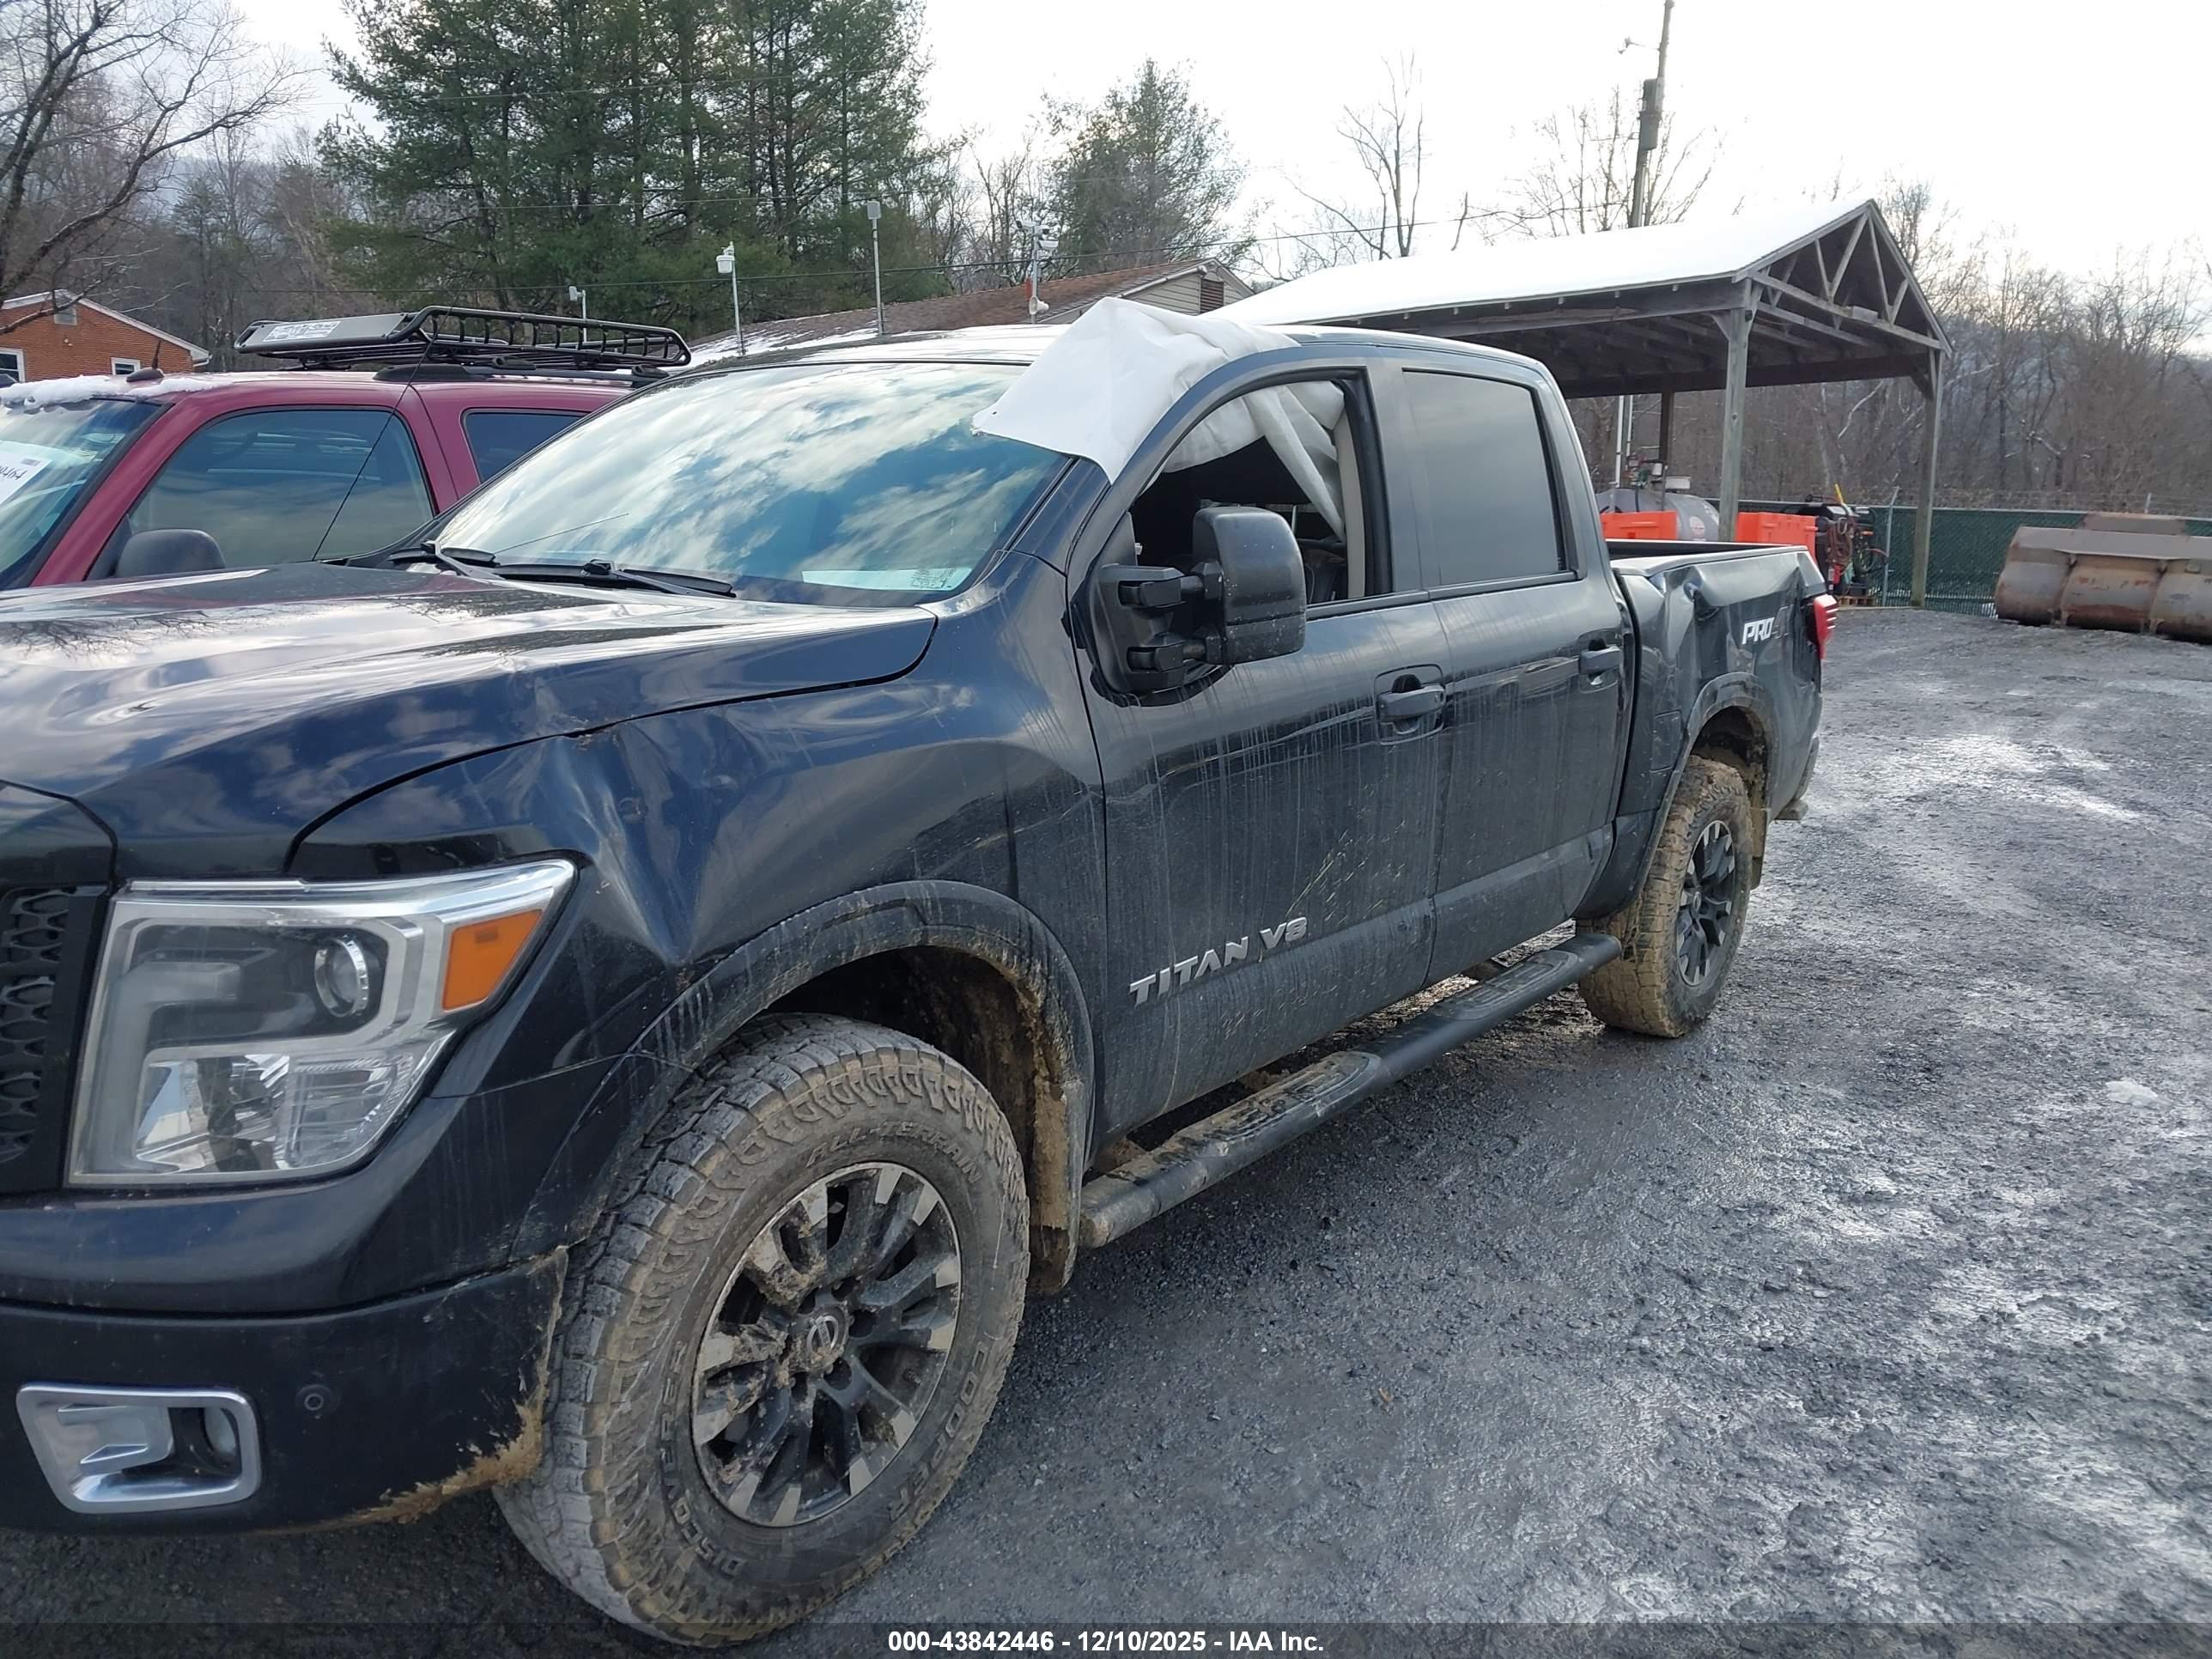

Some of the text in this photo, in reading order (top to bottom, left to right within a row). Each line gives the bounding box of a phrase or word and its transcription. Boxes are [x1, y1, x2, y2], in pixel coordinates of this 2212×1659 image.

[1129, 917, 1307, 1007] TITAN V8
[805, 1121, 982, 1184] ALL-TERRAIN
[889, 1340, 988, 1522] COOPER
